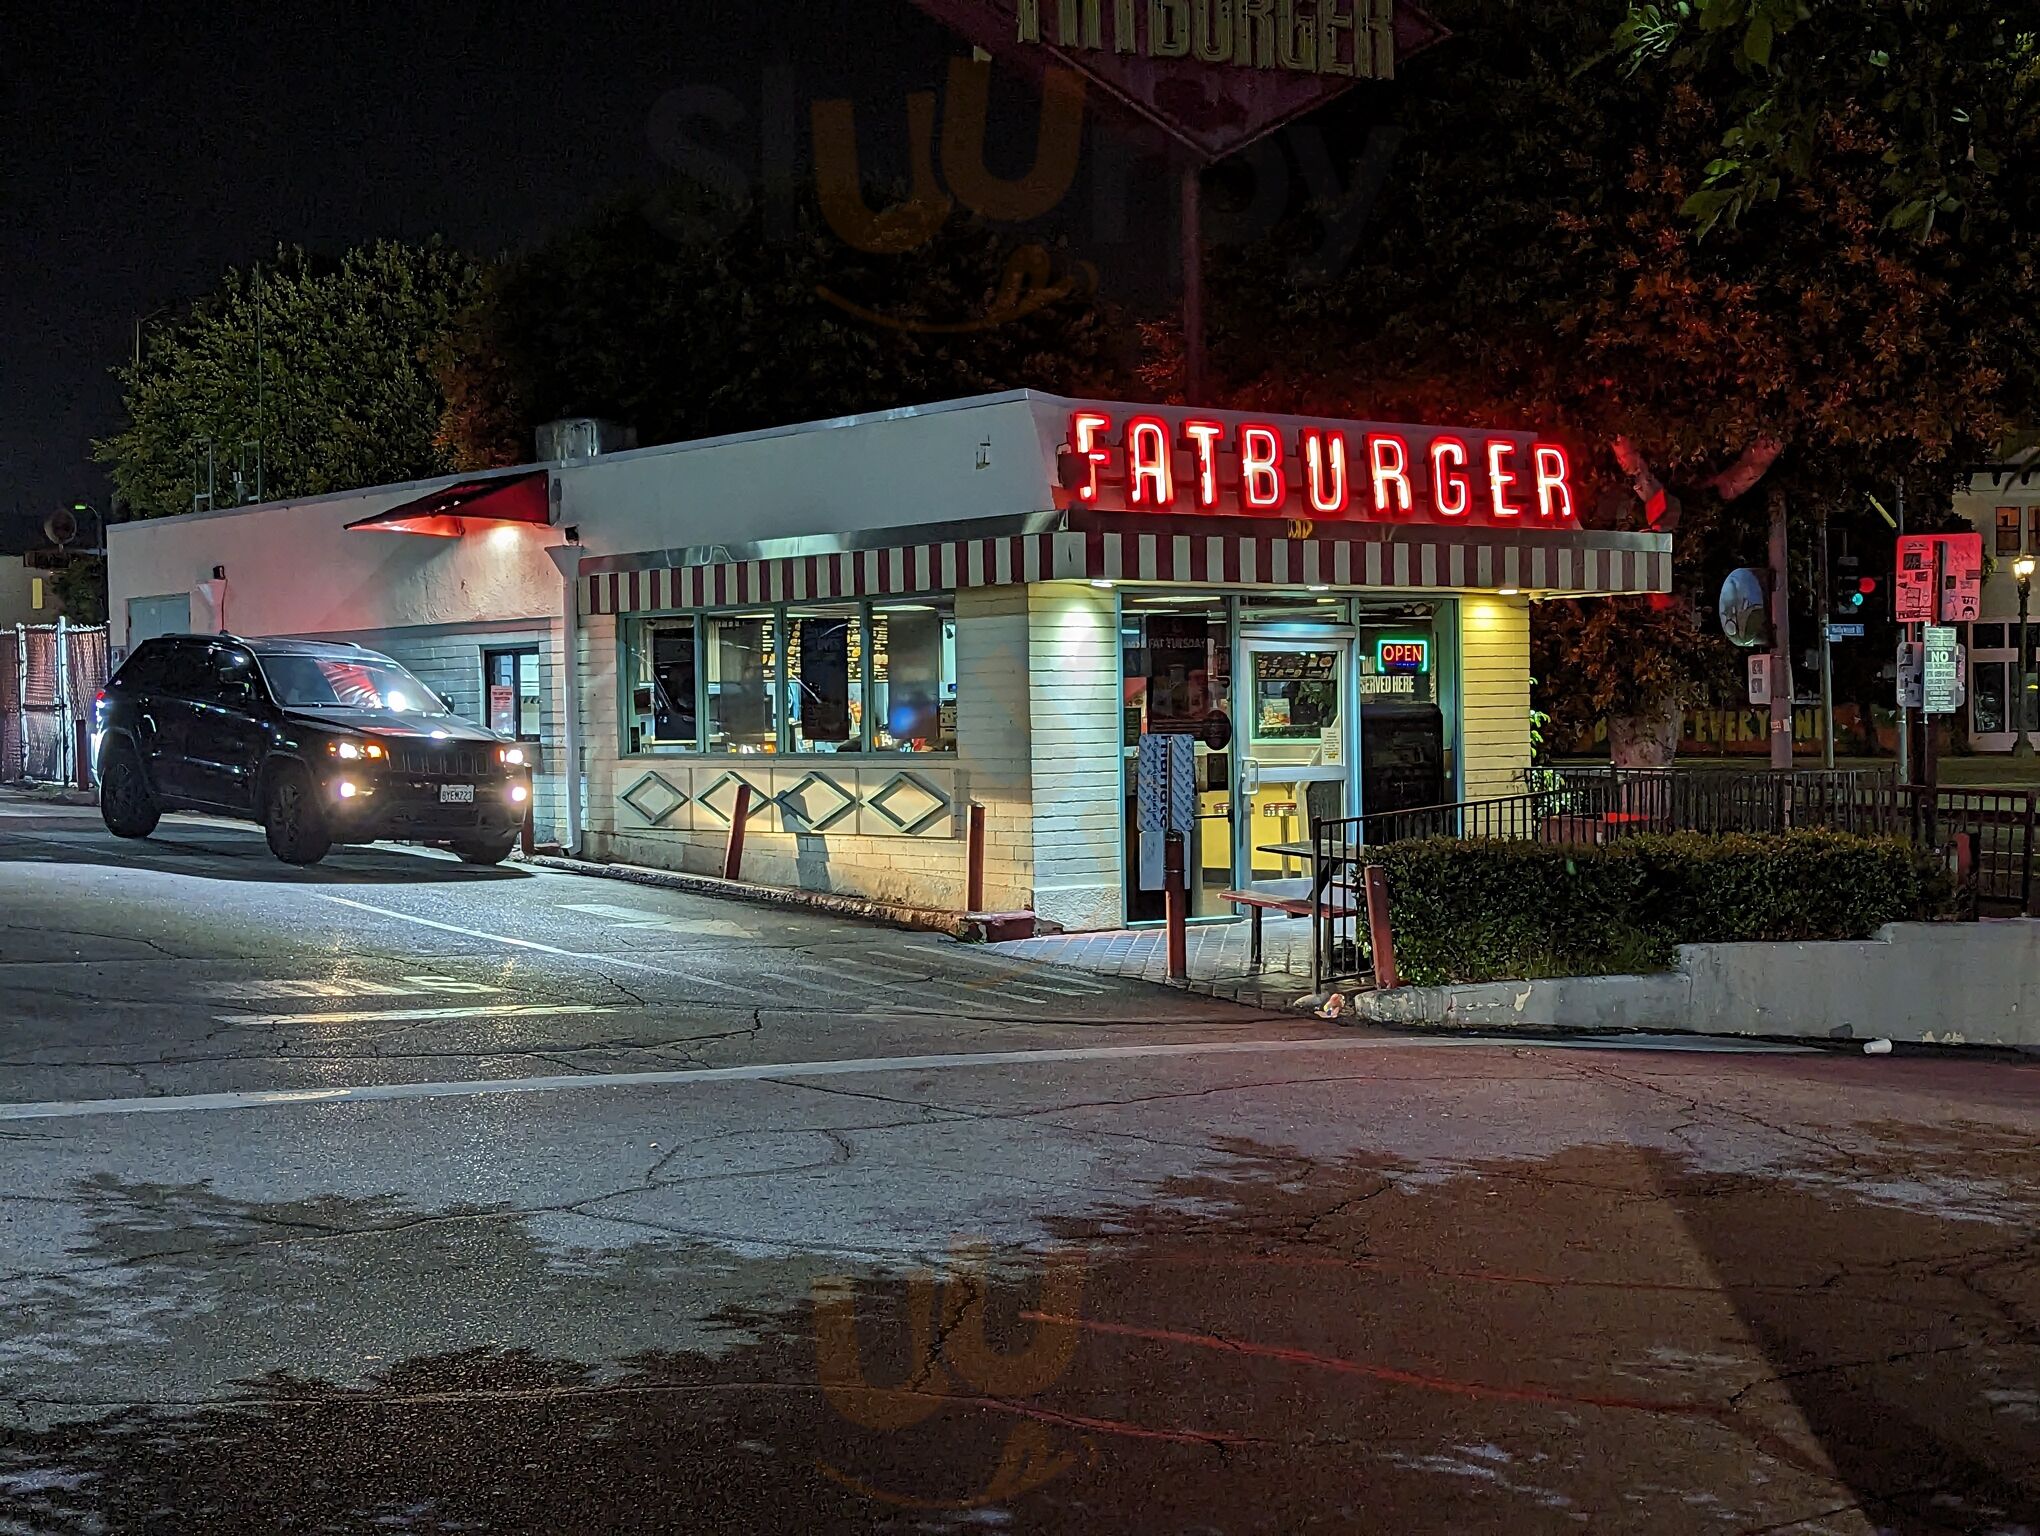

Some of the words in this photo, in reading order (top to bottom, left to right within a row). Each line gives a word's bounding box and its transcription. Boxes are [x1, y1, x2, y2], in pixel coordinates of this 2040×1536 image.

[1068, 411, 1578, 520] FATBURGER
[1382, 645, 1423, 662] OPEN
[1931, 651, 1949, 663] NO
[1360, 675, 1391, 693] SERVED
[1392, 675, 1415, 693] HERE
